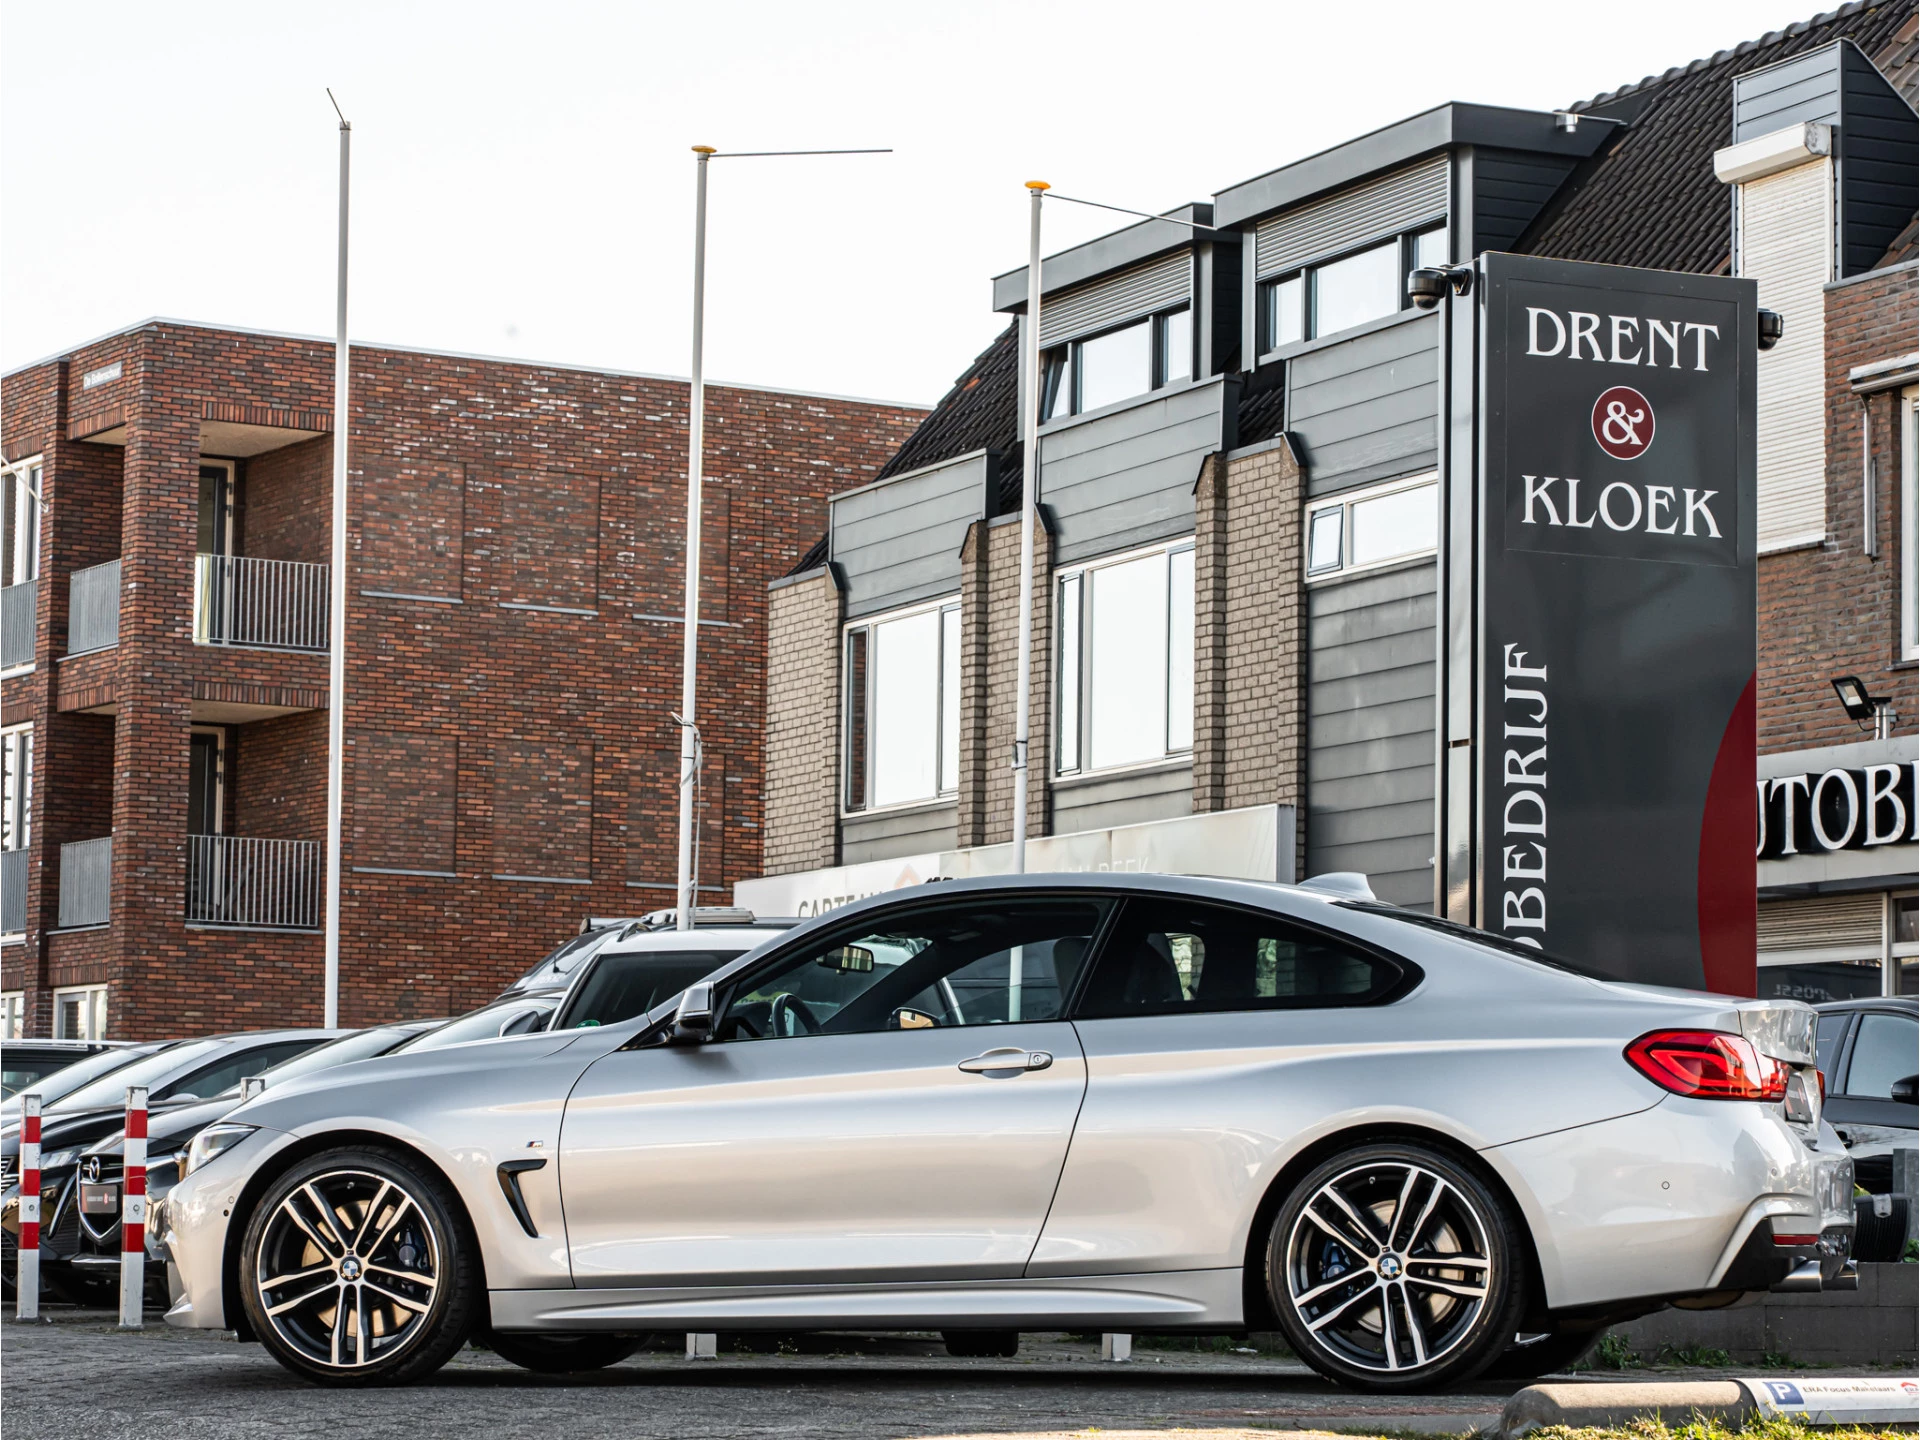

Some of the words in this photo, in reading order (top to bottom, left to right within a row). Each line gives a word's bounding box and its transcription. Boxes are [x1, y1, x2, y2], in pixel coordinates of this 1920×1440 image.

[1525, 306, 1720, 372] DRENT
[1602, 400, 1645, 446] &
[1521, 474, 1723, 539] KLOEK
[1503, 642, 1548, 950] BEDRIJF
[1773, 1383, 1791, 1400] P
